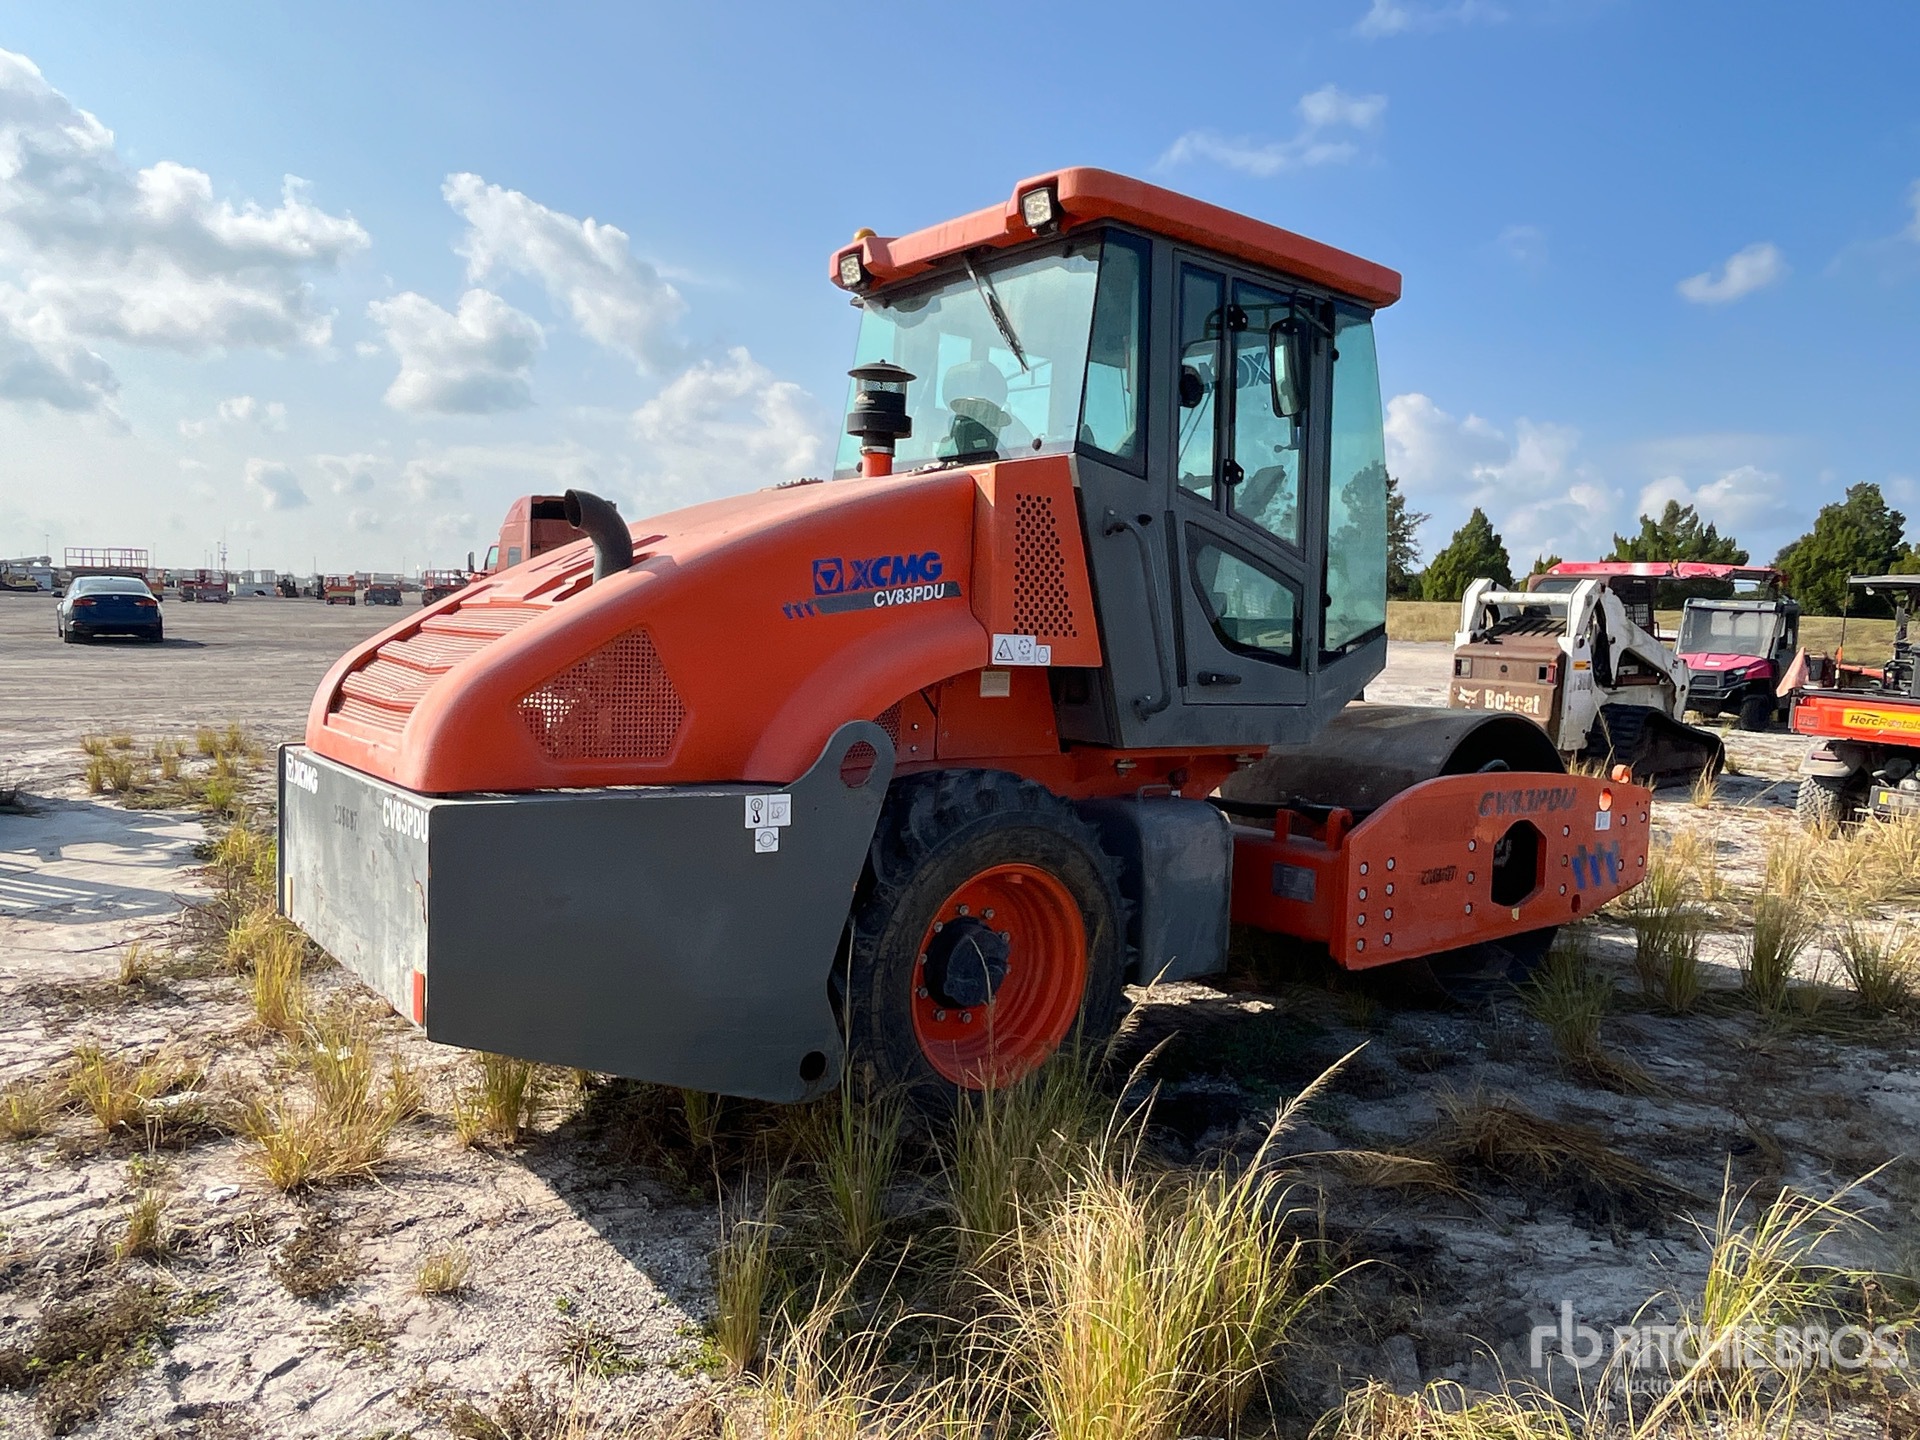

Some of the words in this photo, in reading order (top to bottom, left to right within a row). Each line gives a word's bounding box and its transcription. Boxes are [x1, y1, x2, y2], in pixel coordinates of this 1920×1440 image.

[846, 551, 943, 591] XCMG
[873, 583, 945, 607] CV83PDU
[1484, 689, 1541, 714] Bobcat
[294, 760, 318, 795] XCMG
[382, 797, 430, 843] CV83PDU
